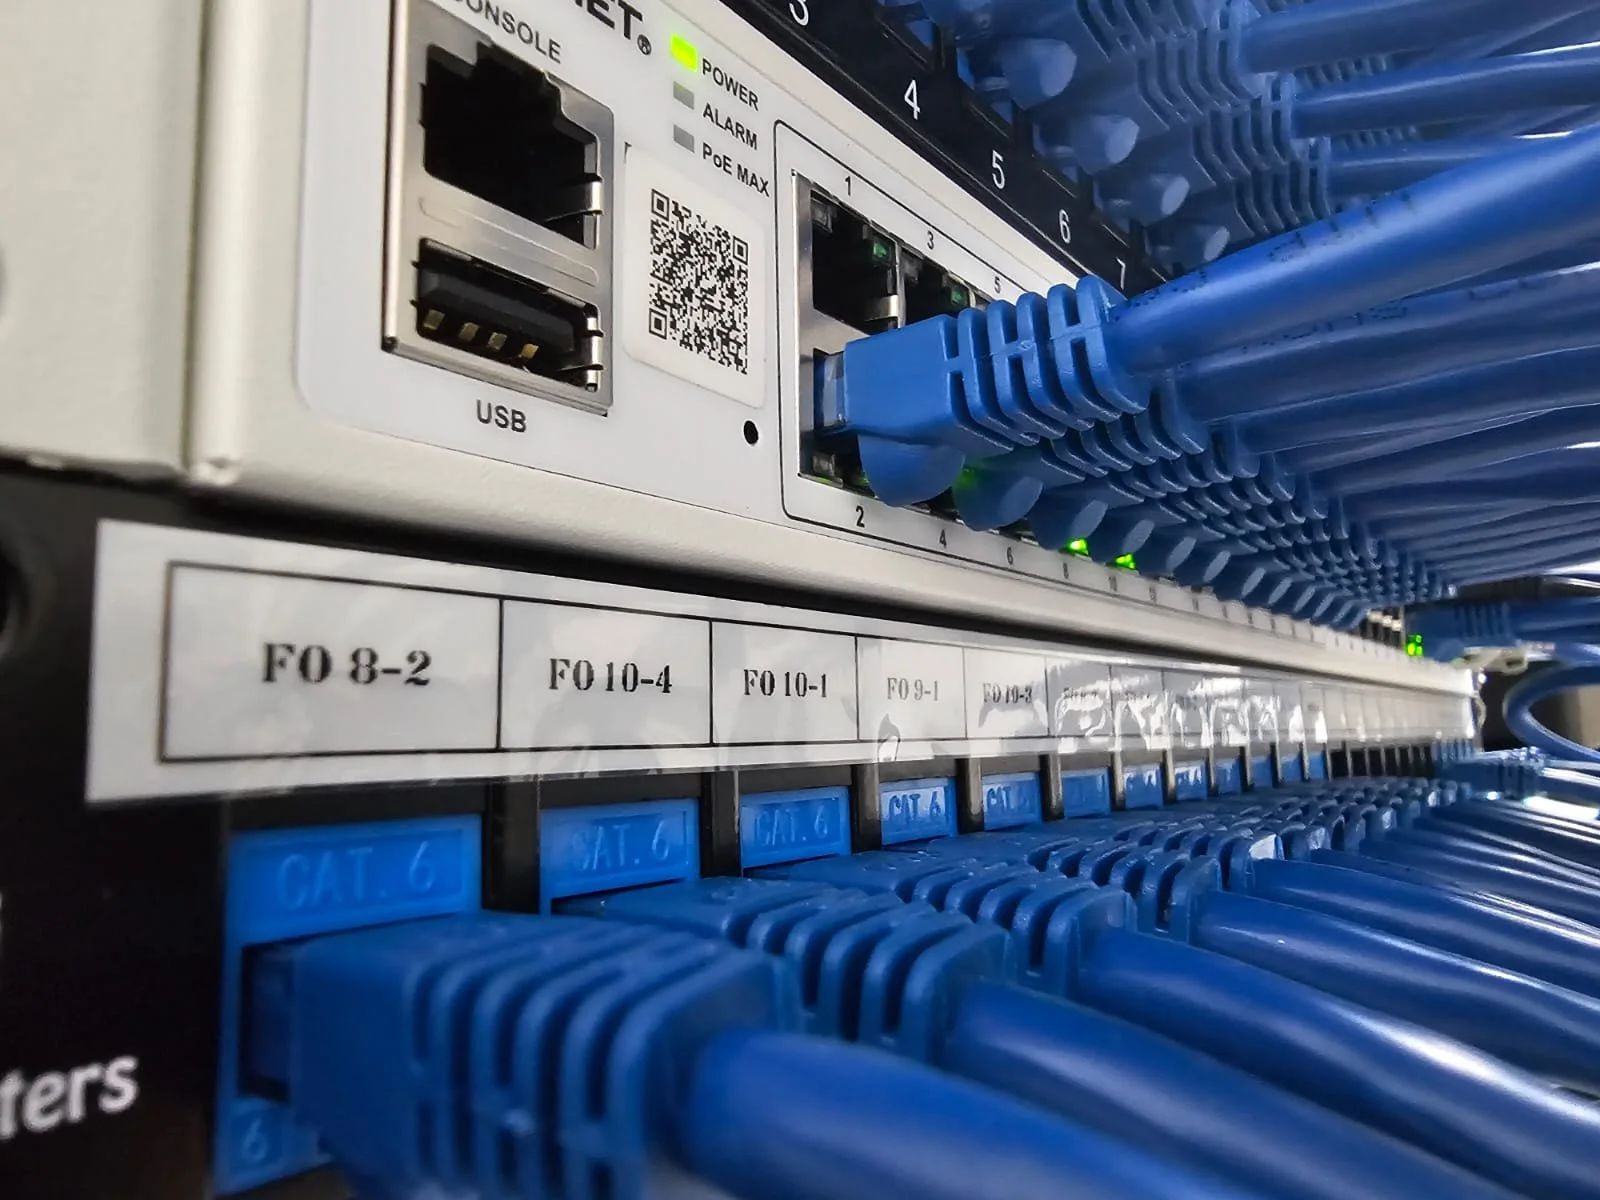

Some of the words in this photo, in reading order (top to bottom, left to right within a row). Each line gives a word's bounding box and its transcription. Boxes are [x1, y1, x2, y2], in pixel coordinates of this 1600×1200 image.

[789, 0, 809, 26] 3
[455, 0, 561, 64] ONSOLE
[702, 58, 758, 111] POWER
[904, 79, 920, 120] 4
[703, 102, 757, 150] ALARM
[703, 142, 732, 176] PoE
[737, 163, 769, 197] MAX
[845, 176, 852, 195] 1
[991, 150, 1005, 190] 5
[927, 230, 935, 250] 3
[1058, 209, 1072, 244] 6
[994, 276, 1001, 293] 5
[1115, 256, 1126, 290] 7
[477, 400, 526, 432] USB
[855, 505, 865, 528] 2
[939, 529, 947, 549] 4
[1007, 547, 1014, 565] 6
[262, 643, 331, 684] FO
[349, 647, 432, 686] 8-2
[549, 658, 594, 692] FO
[604, 662, 672, 694] 10-4
[743, 669, 776, 697] FO
[784, 672, 828, 699] 10-1
[887, 677, 909, 701] FO
[914, 680, 939, 702] 9-1
[814, 805, 828, 839] 6
[651, 821, 669, 860] 6
[277, 848, 388, 910] CAT.
[408, 840, 434, 893] 6
[241, 1119, 268, 1162] 6
